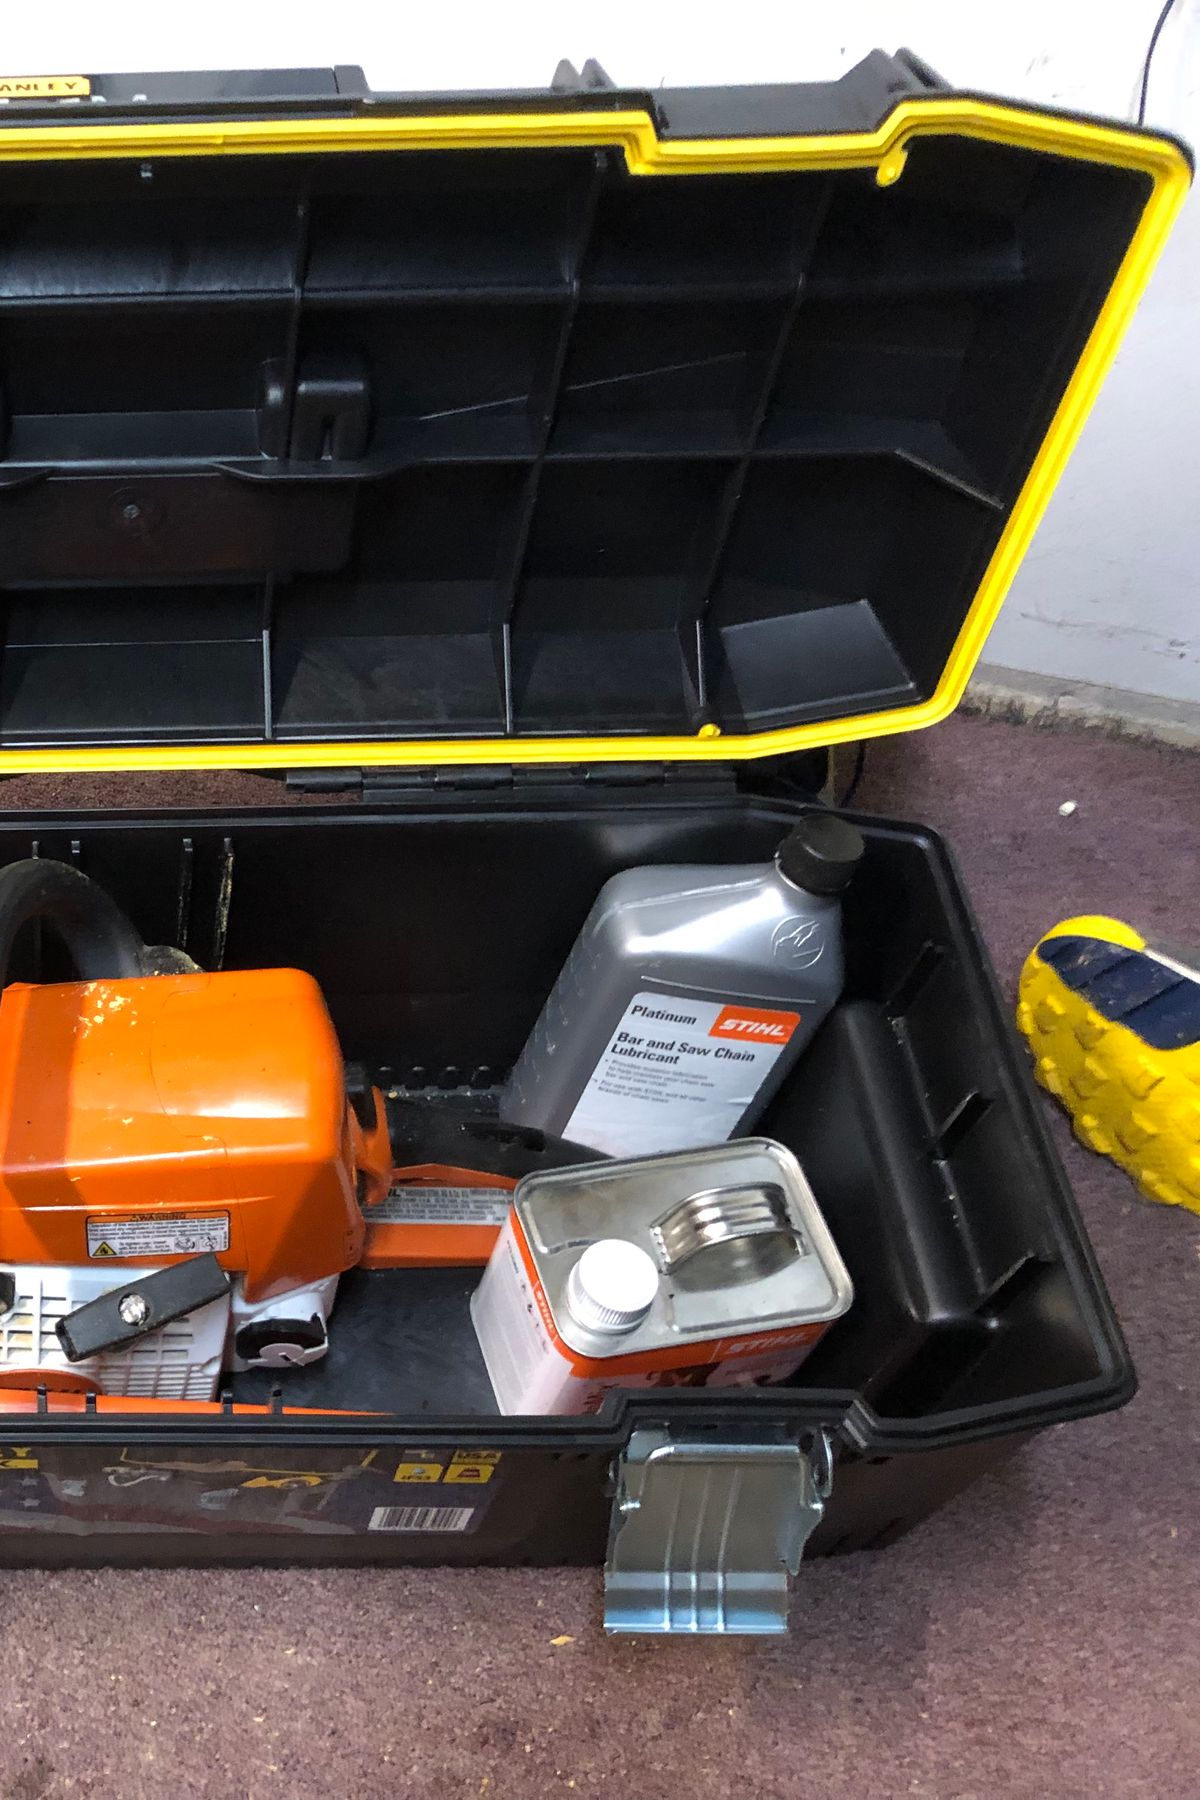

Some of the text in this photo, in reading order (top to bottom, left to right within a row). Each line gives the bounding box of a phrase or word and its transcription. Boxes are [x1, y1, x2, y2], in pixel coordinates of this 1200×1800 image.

[631, 1005, 697, 1025] Platinum
[719, 1019, 785, 1036] STIHL
[611, 1044, 680, 1065] Lubricant
[617, 1032, 756, 1062] Bar and Saw Chain
